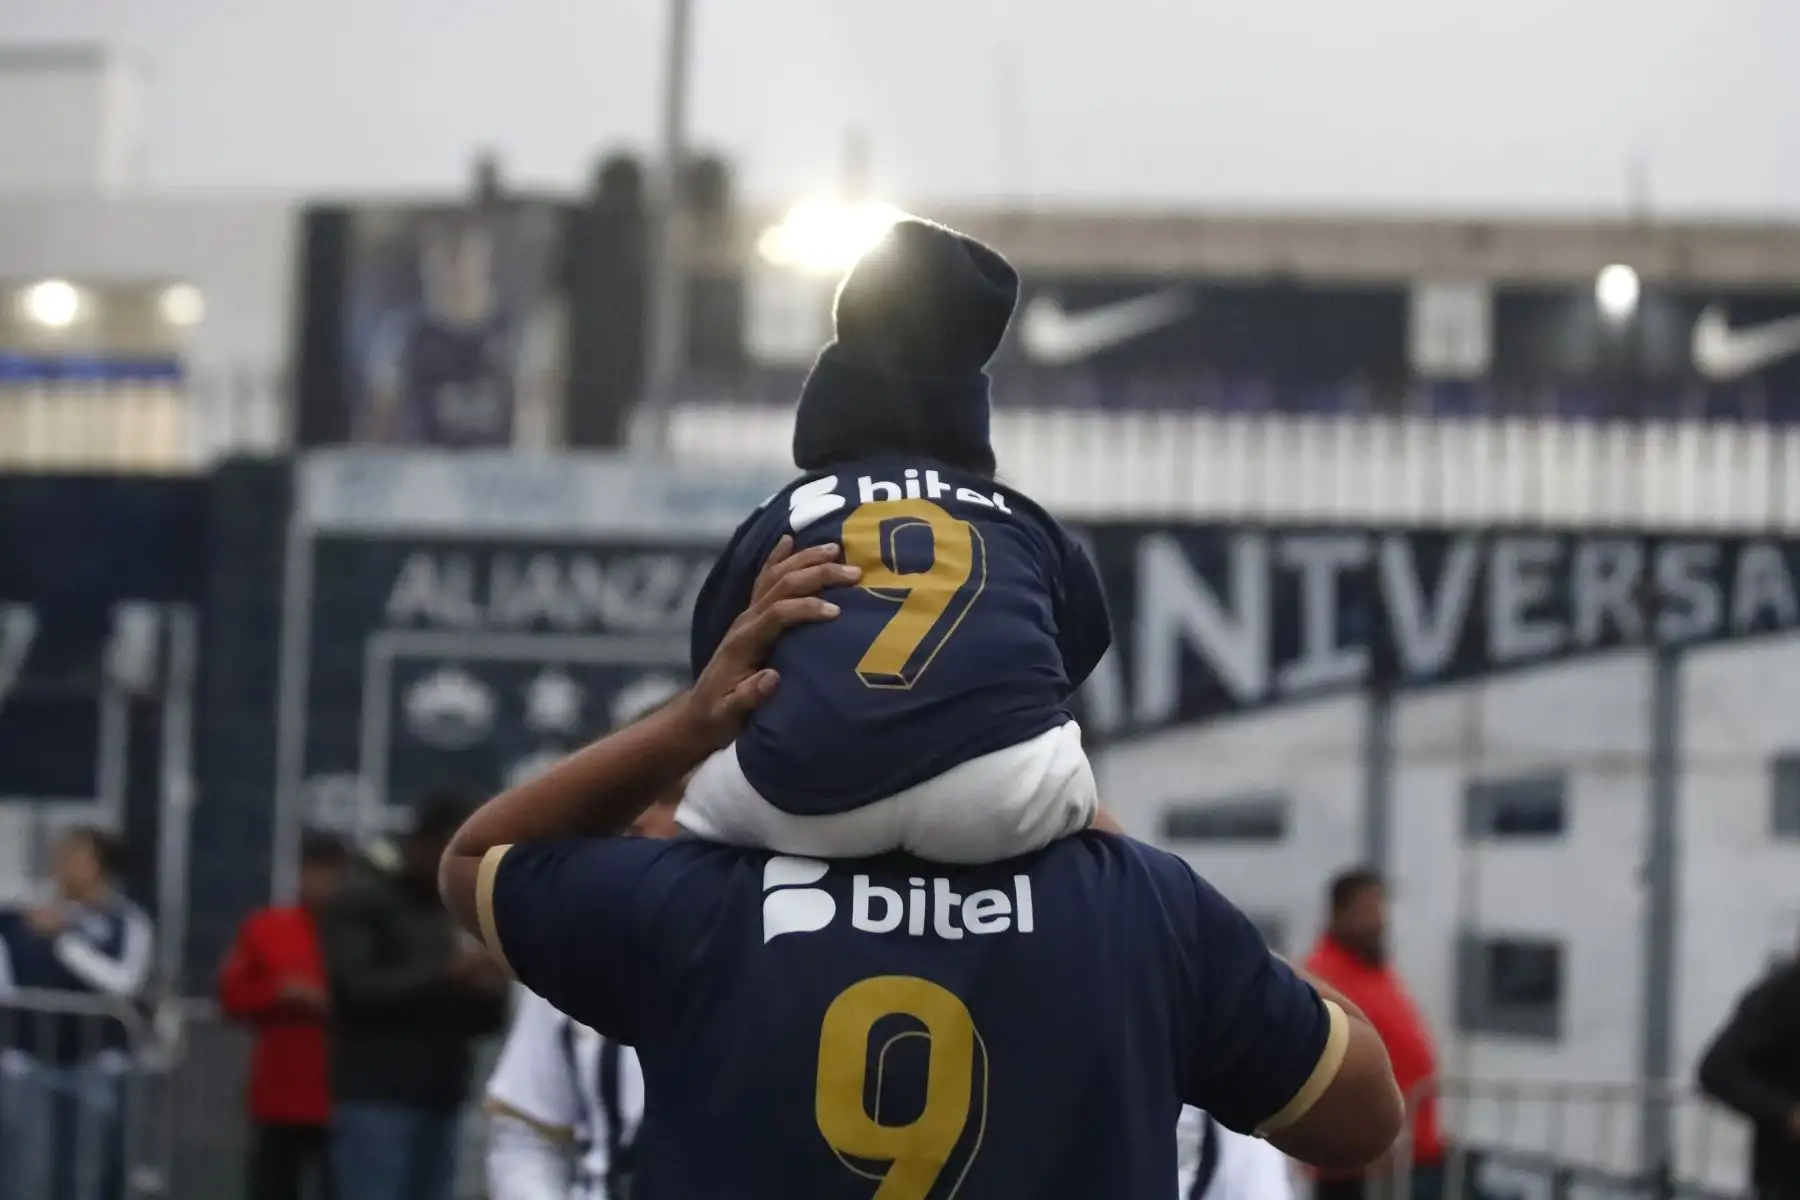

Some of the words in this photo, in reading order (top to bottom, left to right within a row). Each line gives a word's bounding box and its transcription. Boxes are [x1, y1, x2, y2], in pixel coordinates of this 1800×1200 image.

[841, 497, 987, 690] 9
[852, 874, 1034, 940] bitel
[815, 974, 988, 1200] 9
